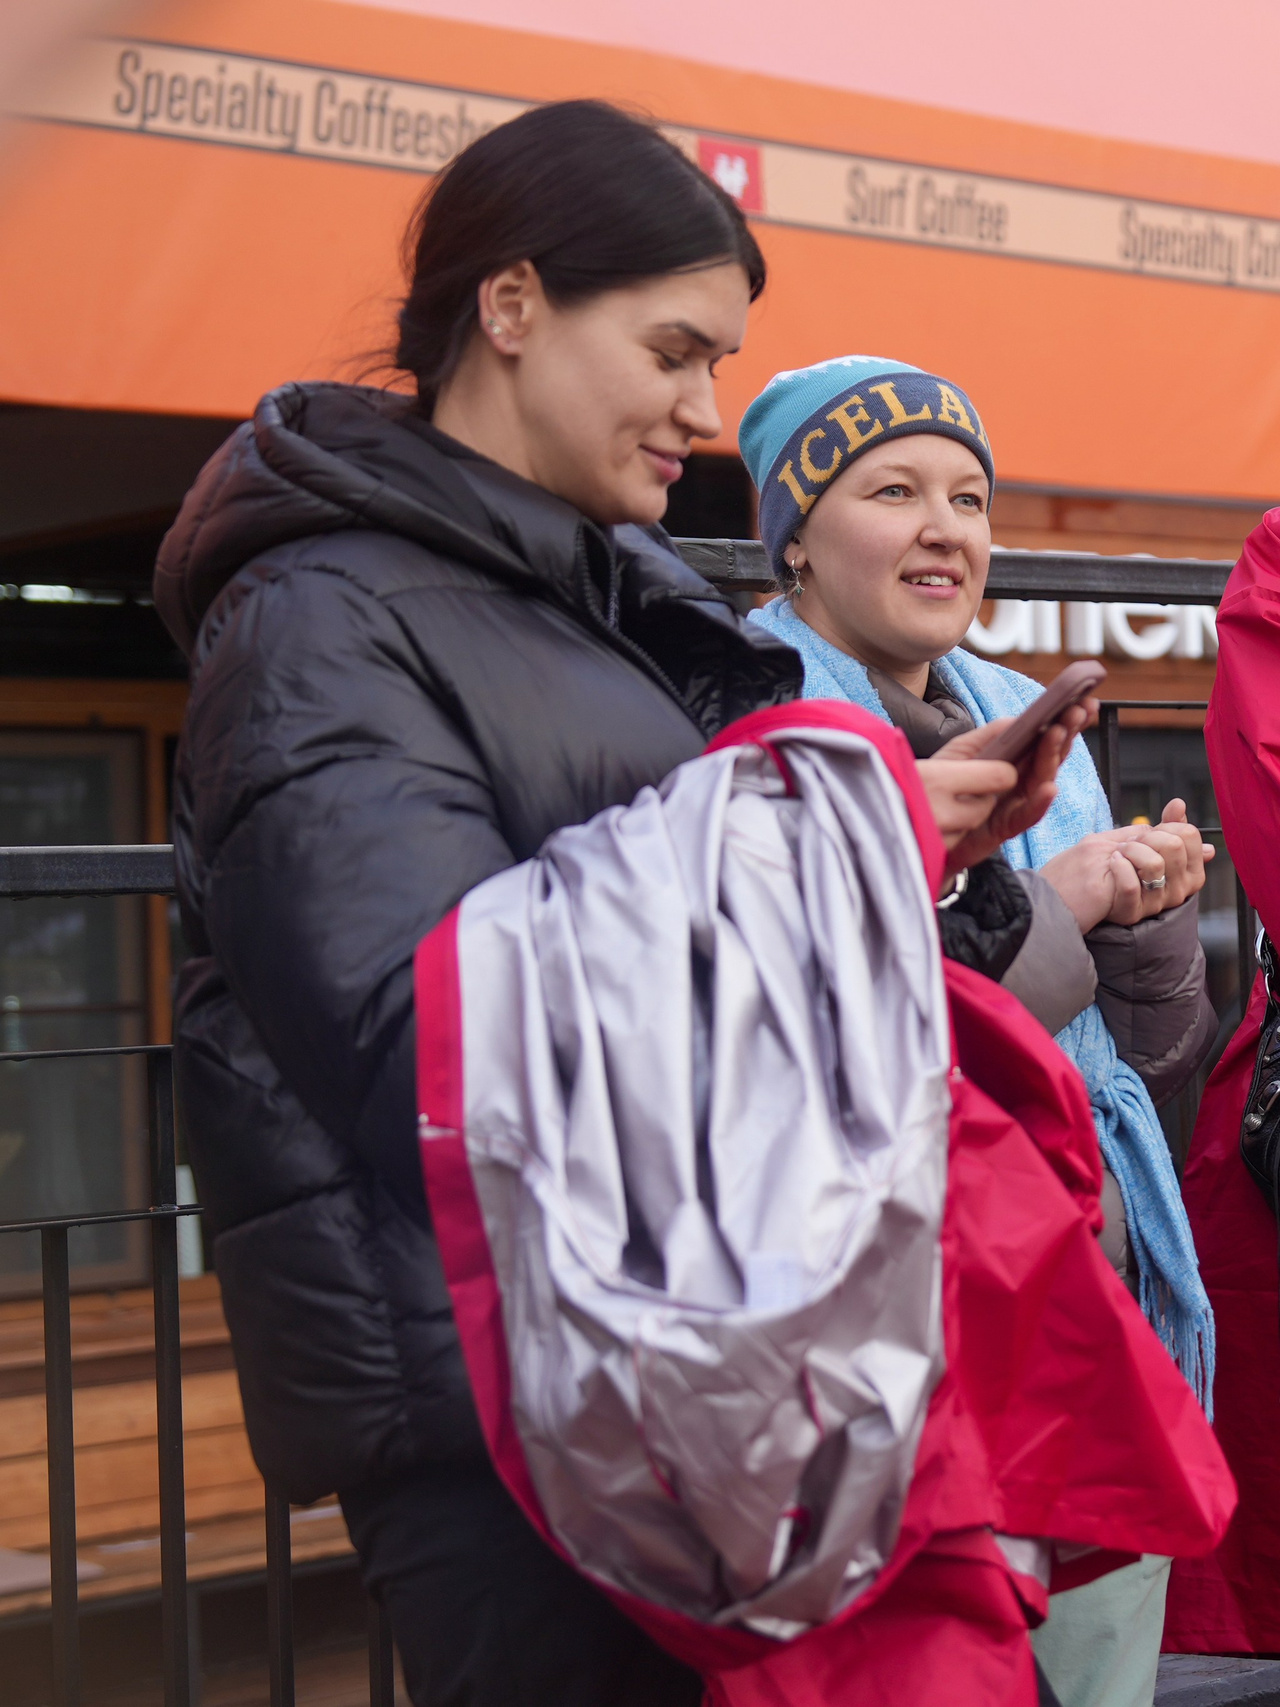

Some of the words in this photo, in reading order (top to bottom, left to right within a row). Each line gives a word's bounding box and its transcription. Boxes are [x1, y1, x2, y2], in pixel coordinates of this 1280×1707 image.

[114, 48, 301, 153] Specialty
[845, 163, 908, 230] Surf
[916, 174, 1008, 243] Coffee
[1118, 201, 1237, 286] Specialty
